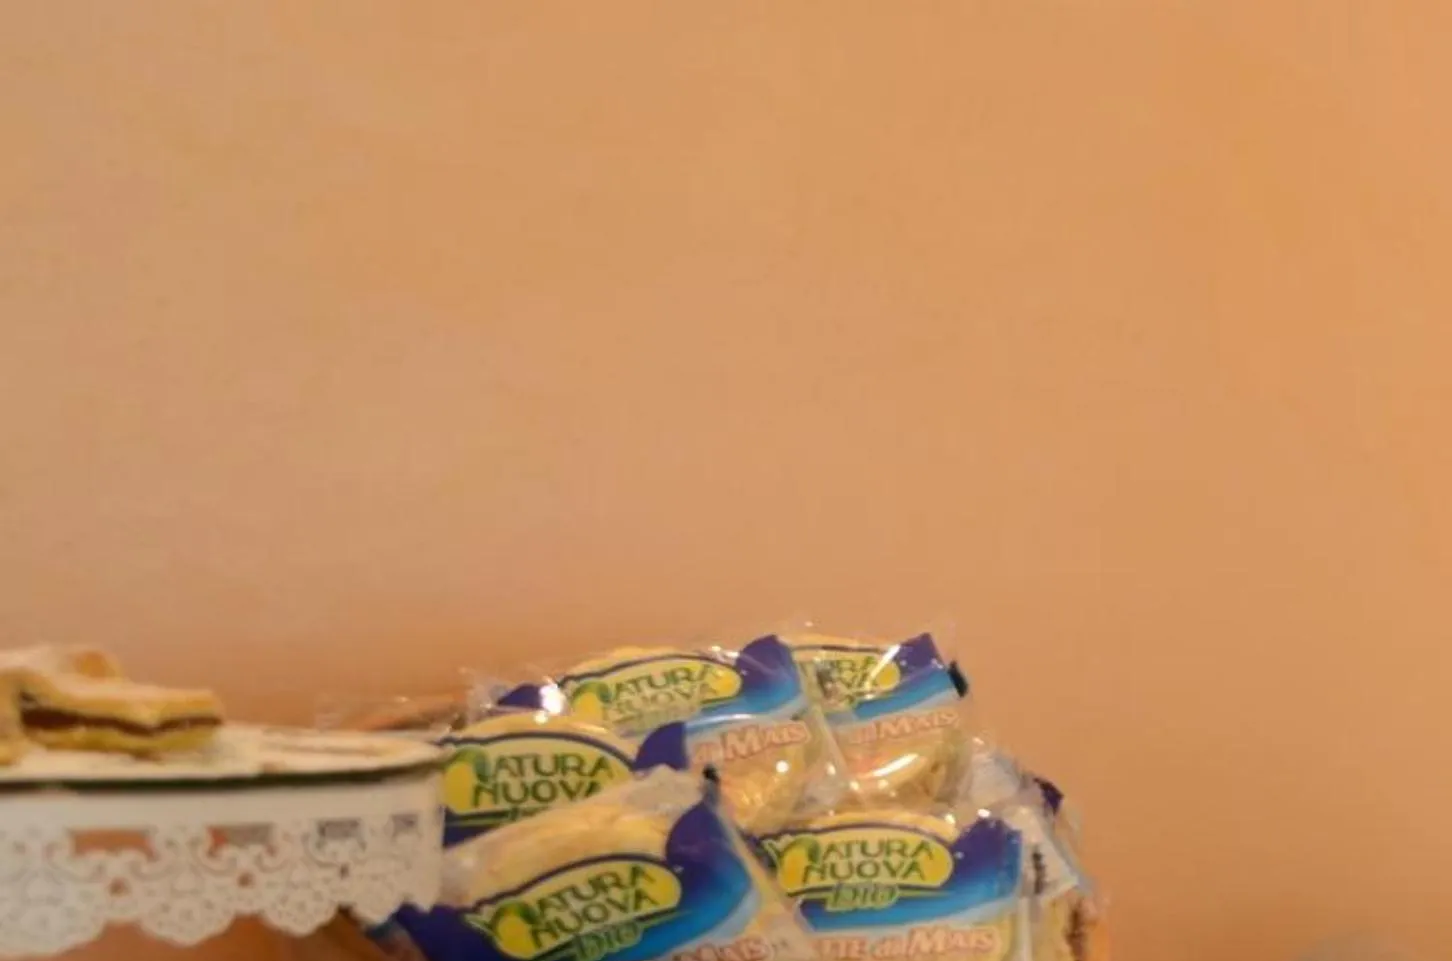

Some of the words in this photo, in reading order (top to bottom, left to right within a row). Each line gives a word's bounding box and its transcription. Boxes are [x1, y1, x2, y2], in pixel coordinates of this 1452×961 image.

[802, 860, 926, 884] NUOVA
[530, 887, 661, 949] NUOVA
[907, 925, 993, 958] MAIS
